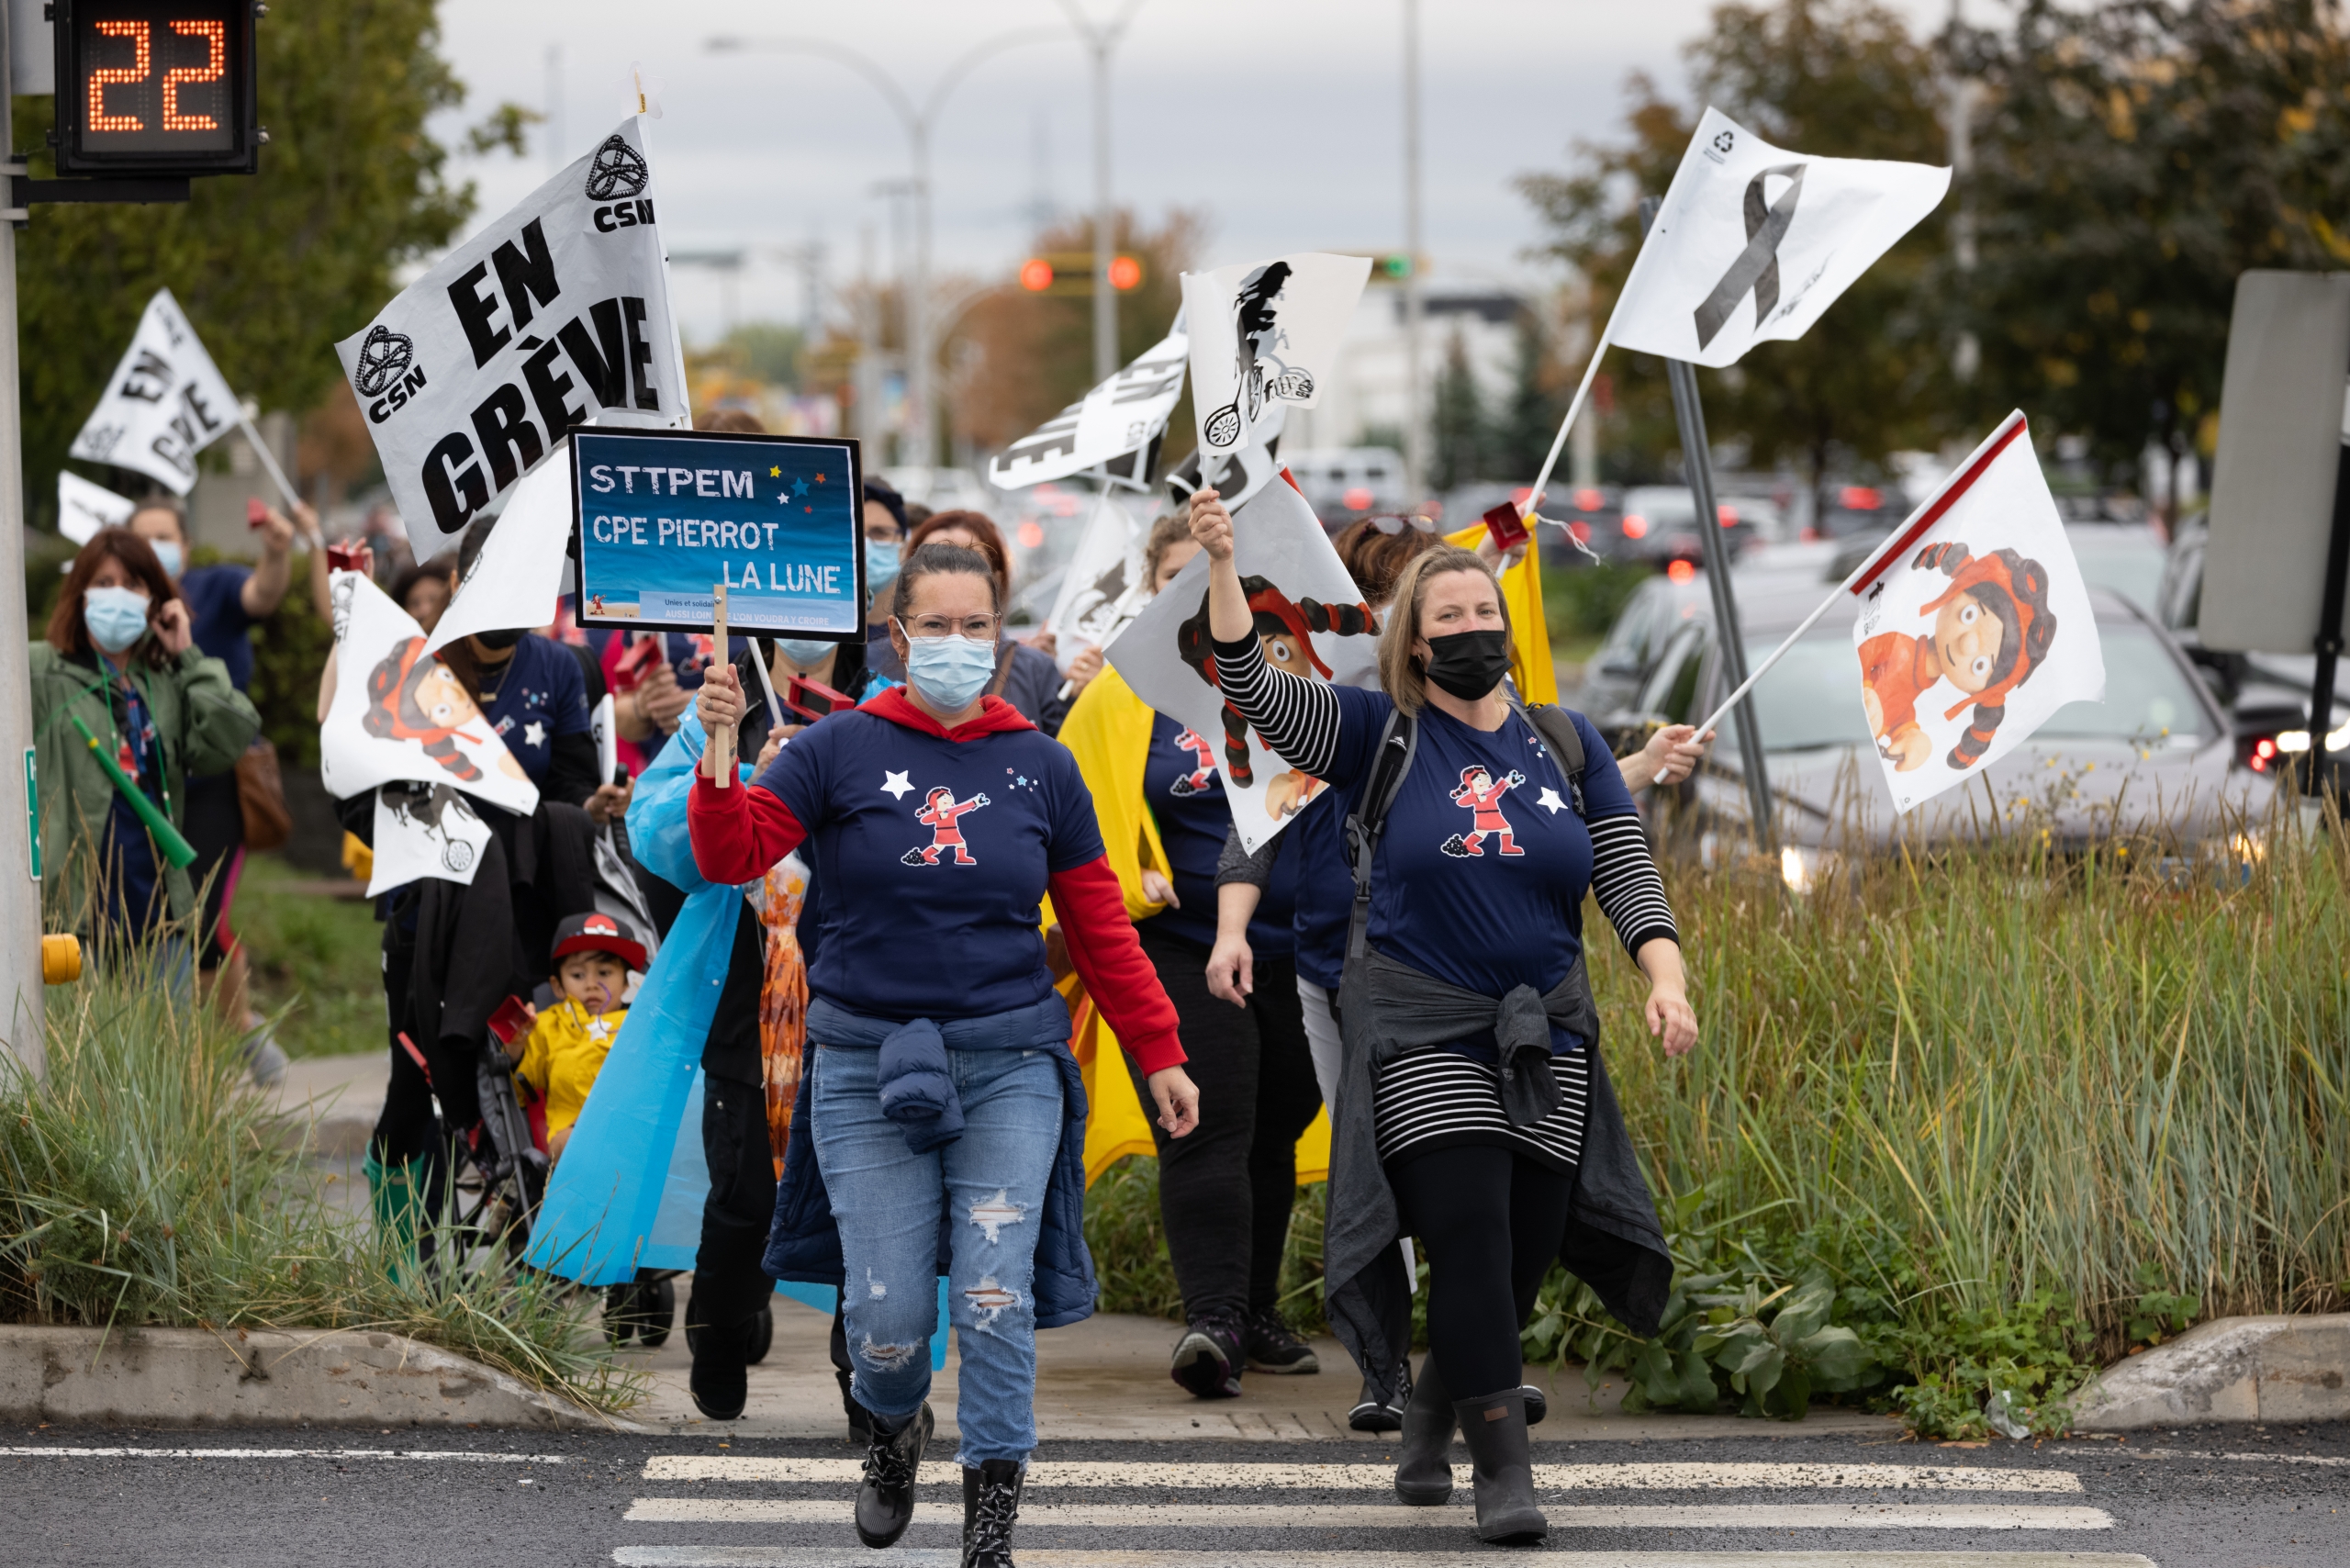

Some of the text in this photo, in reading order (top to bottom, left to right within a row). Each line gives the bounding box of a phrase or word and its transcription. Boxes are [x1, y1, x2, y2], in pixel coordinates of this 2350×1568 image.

[89, 20, 224, 130] 22
[593, 199, 655, 233] CSN
[447, 215, 561, 370] EN
[368, 364, 428, 424] CSN
[422, 297, 660, 534] GRÈVE
[590, 465, 755, 498] STTPEM
[593, 515, 779, 551] CPE PIERROT
[723, 561, 841, 594] LA LUNE
[665, 599, 682, 607] Unies
[666, 610, 689, 619] AUSSI
[691, 610, 712, 620] LOIN
[754, 613, 789, 623] VOUDRA
[790, 615, 796, 624] Y
[798, 616, 830, 626] CROIRE
